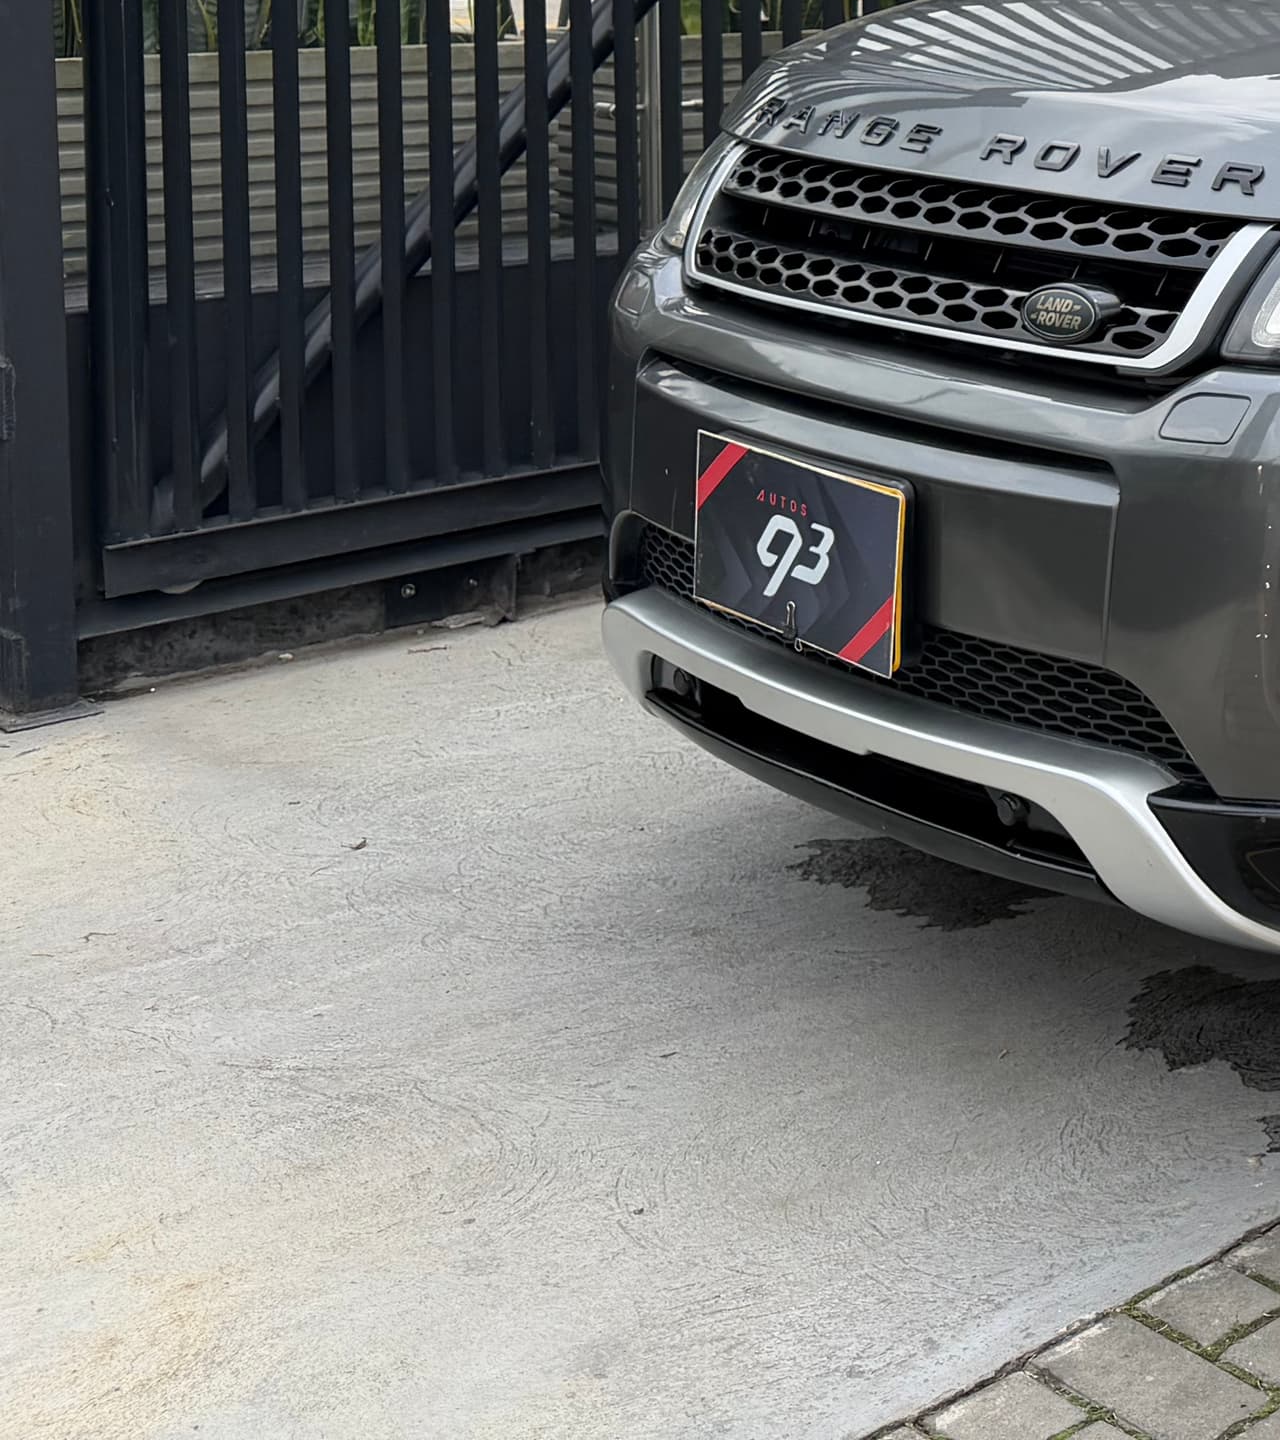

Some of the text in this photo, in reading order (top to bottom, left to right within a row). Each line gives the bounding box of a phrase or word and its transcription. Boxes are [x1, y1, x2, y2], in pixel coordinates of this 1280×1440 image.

[755, 96, 1266, 196] RANGE ROVER
[1036, 295, 1073, 312] LAND
[1036, 311, 1082, 330] ROVER
[756, 490, 808, 516] AUTOS
[757, 514, 835, 597] 93
